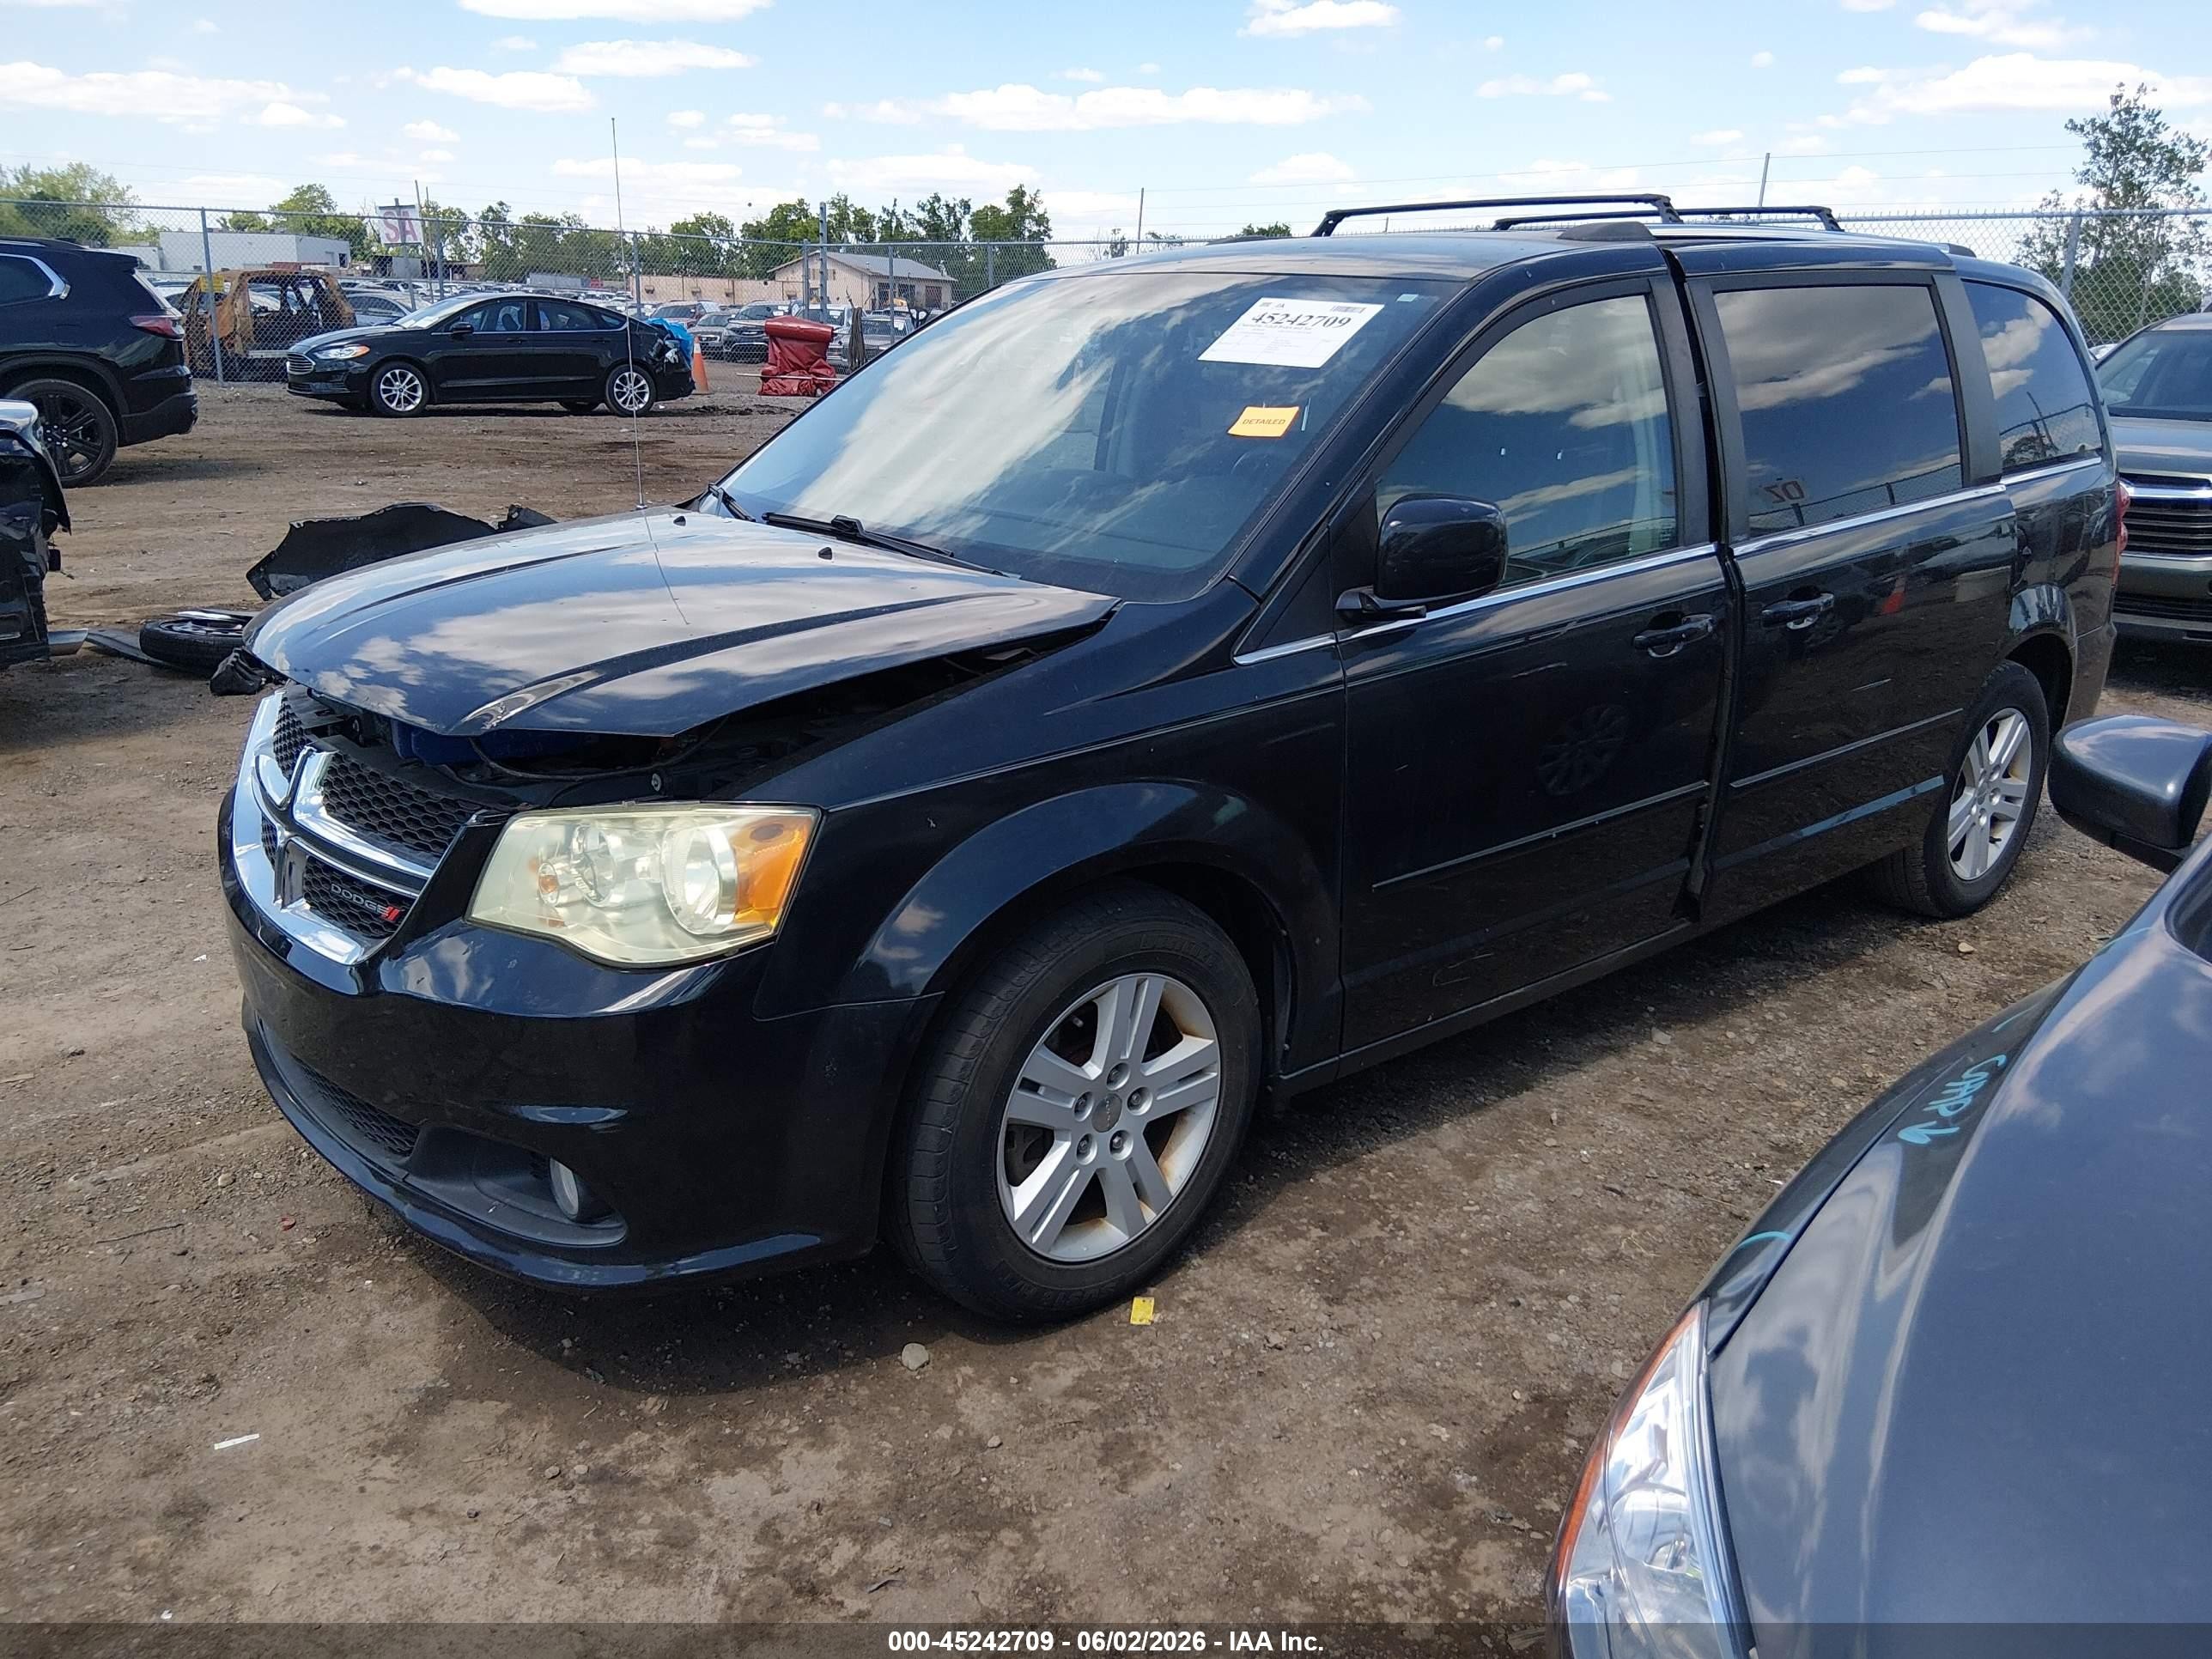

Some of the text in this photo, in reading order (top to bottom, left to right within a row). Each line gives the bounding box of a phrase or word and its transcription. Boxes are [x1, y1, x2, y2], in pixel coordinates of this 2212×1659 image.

[383, 210, 418, 243] SA
[1252, 312, 1352, 329] 45242709
[331, 884, 389, 918] DODGE
